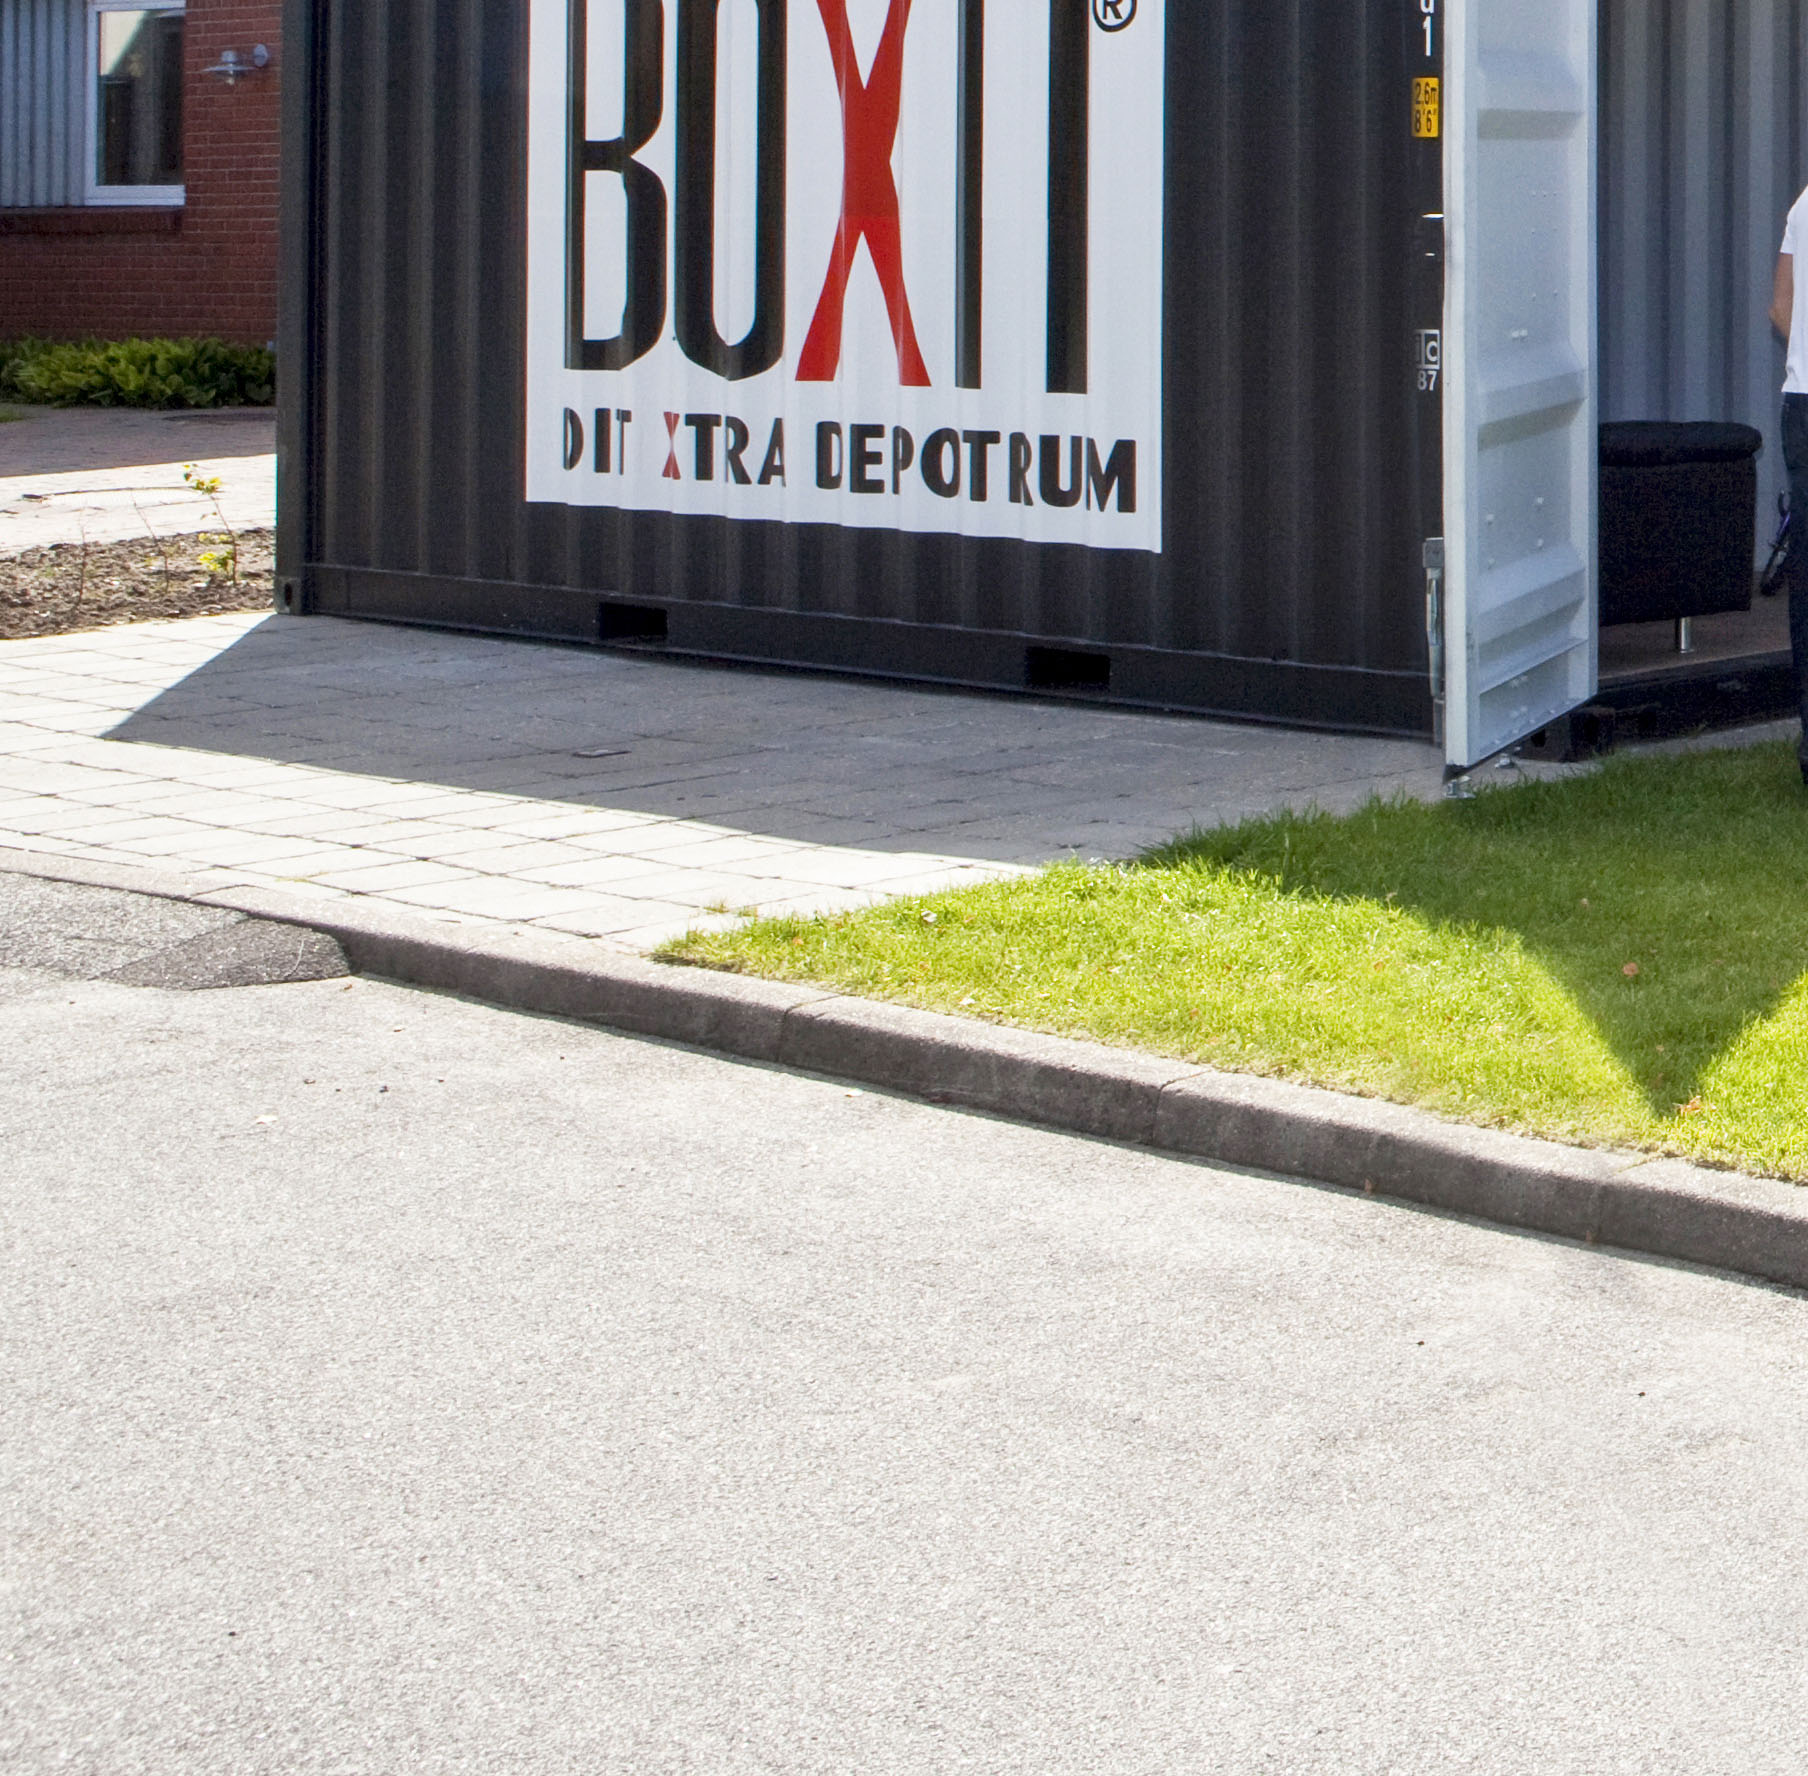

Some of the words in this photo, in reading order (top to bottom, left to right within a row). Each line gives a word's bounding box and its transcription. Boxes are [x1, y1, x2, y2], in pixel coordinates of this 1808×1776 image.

[1417, 370, 1438, 392] 87
[563, 407, 632, 476] DIT
[661, 411, 787, 487] XTRA
[815, 420, 1137, 513] DEPOTRUM
